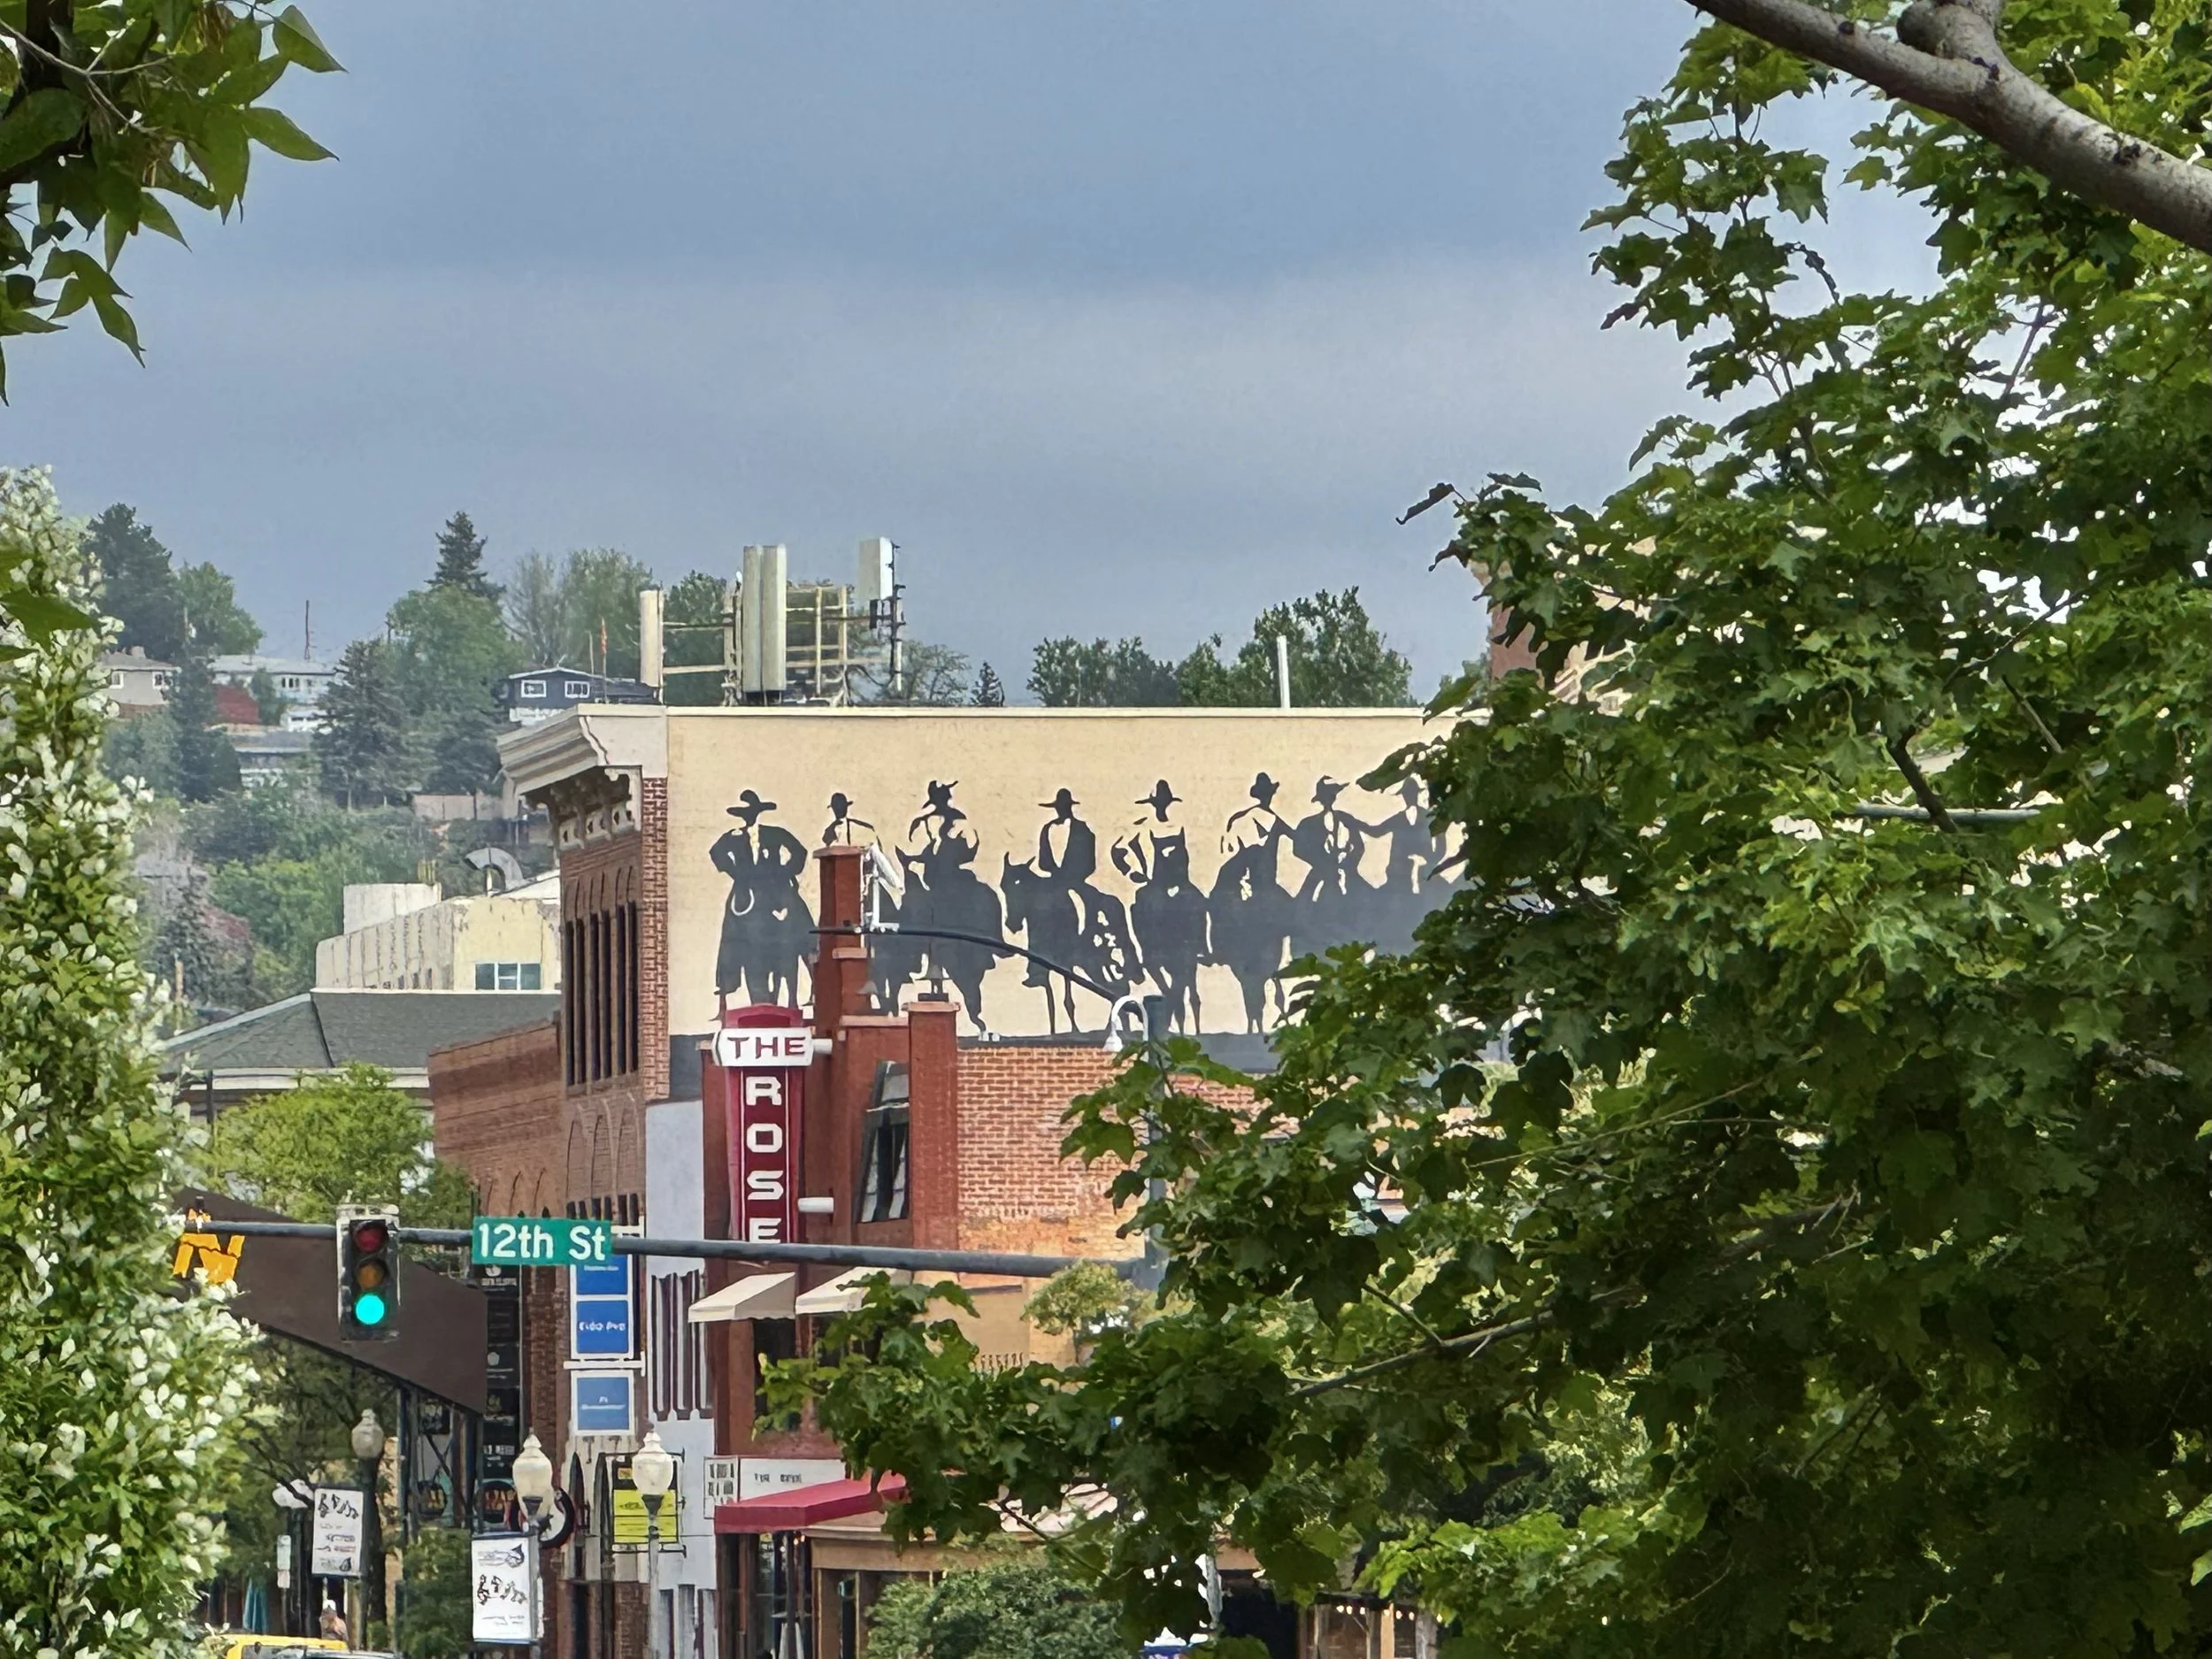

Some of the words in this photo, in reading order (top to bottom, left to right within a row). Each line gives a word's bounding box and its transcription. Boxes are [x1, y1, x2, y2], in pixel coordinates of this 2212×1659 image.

[726, 1036, 806, 1060] THE
[745, 1076, 784, 1244] ROSE
[479, 1223, 554, 1259] 12th
[568, 1225, 606, 1261] St
